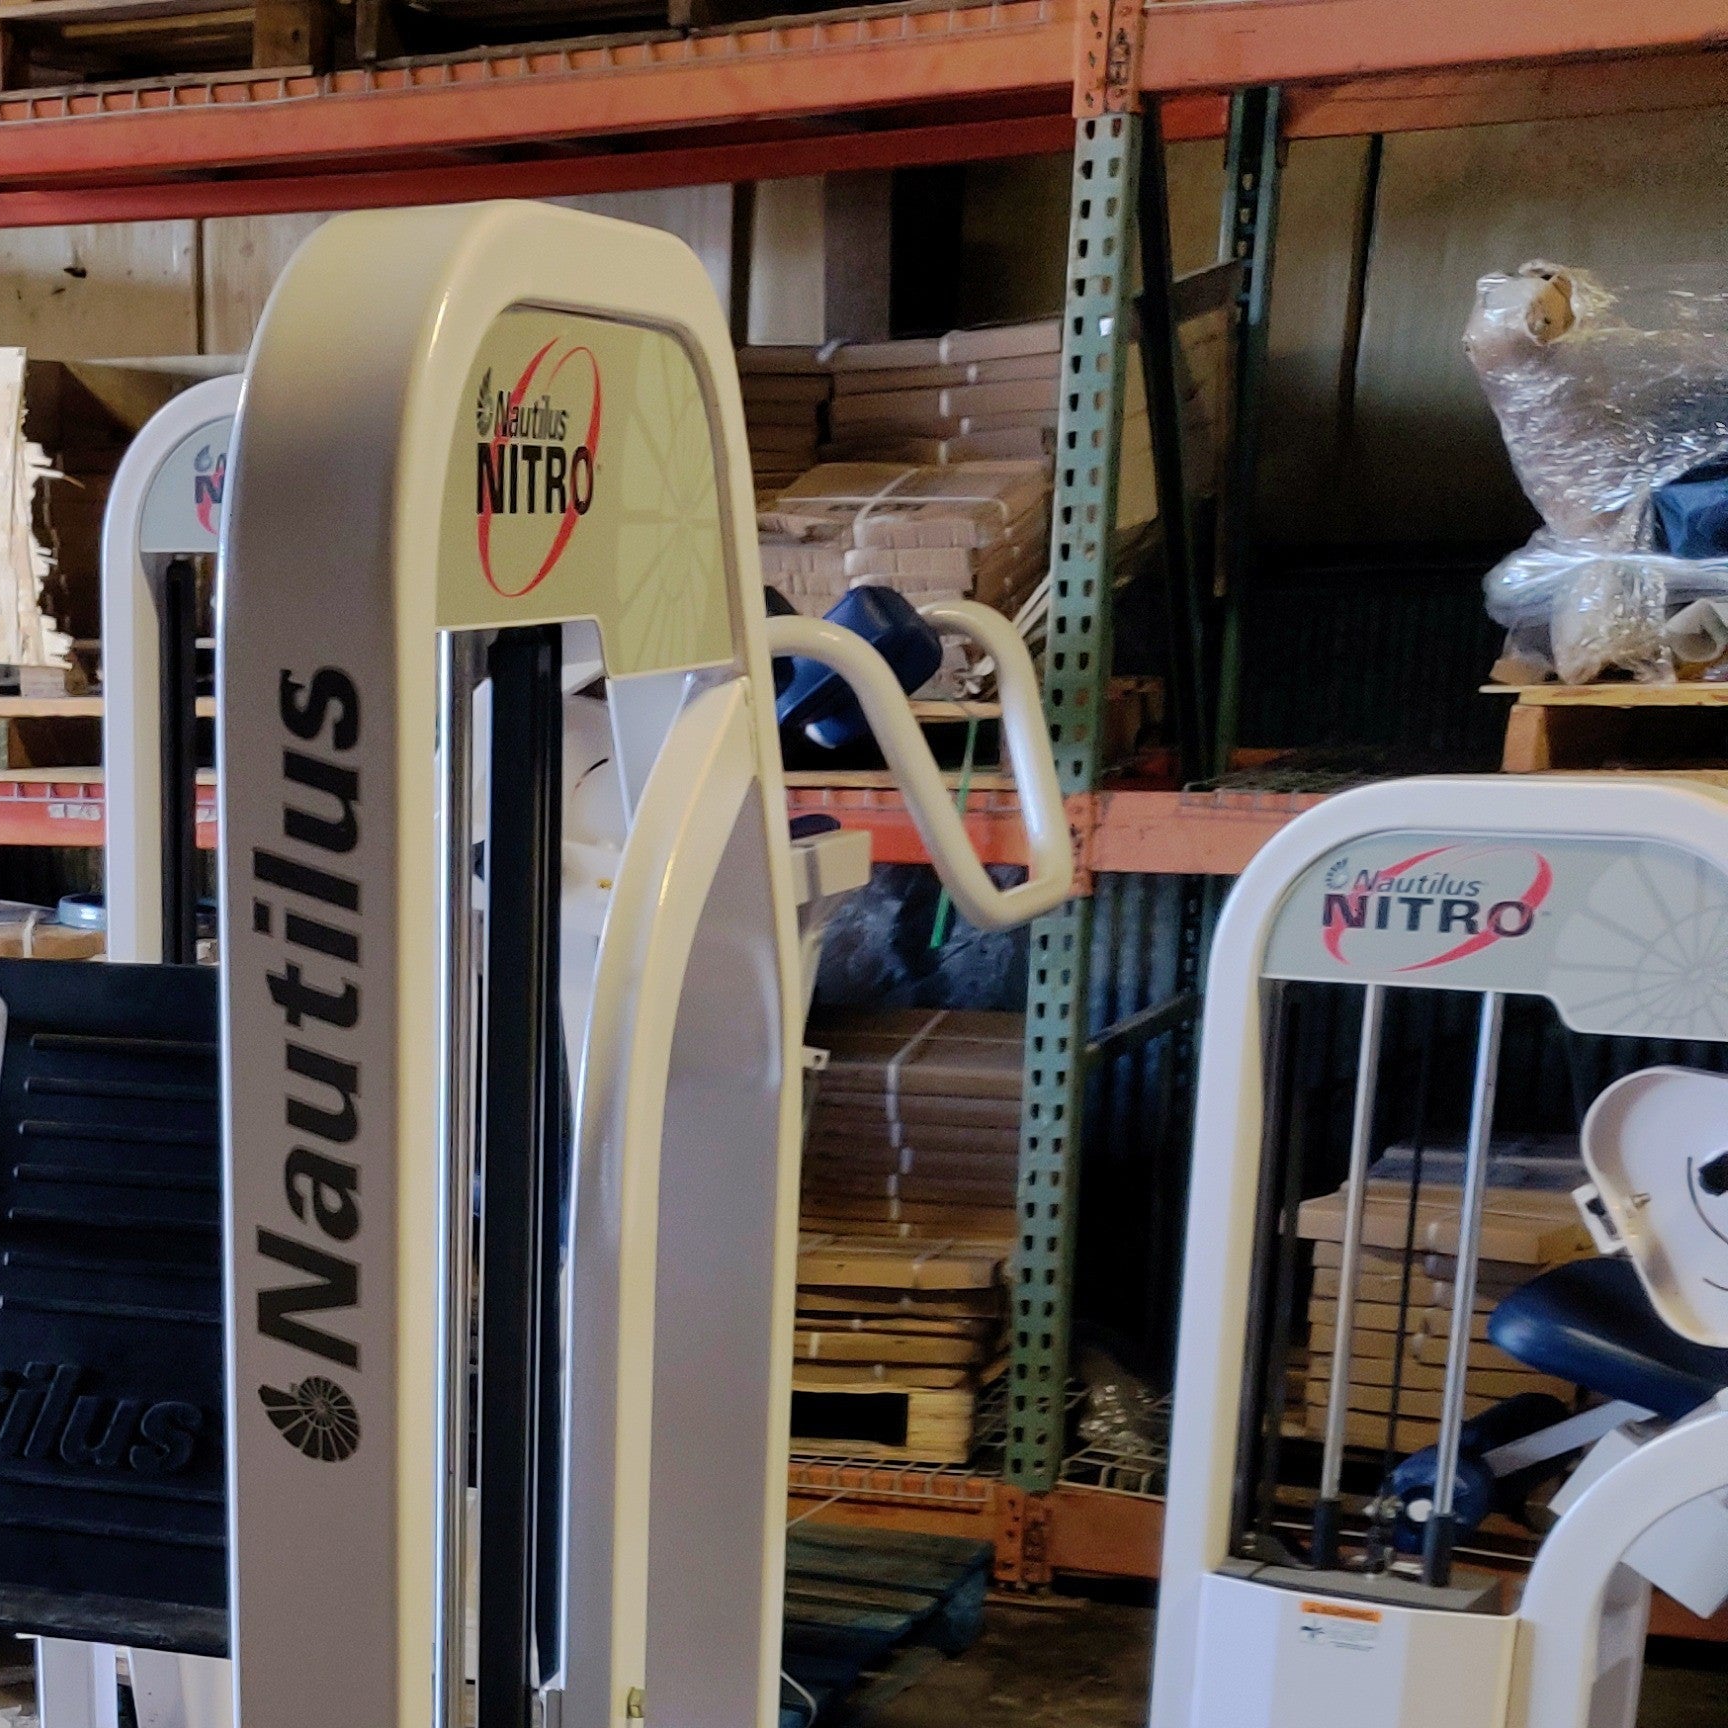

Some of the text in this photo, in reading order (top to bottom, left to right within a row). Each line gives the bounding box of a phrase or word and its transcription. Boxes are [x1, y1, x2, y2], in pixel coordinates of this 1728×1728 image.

[493, 389, 569, 441] Nautilus
[476, 442, 594, 516] NITRO
[1353, 868, 1482, 898] Nautilus
[1322, 892, 1535, 938] NITRO
[252, 666, 362, 1372] Nautilus
